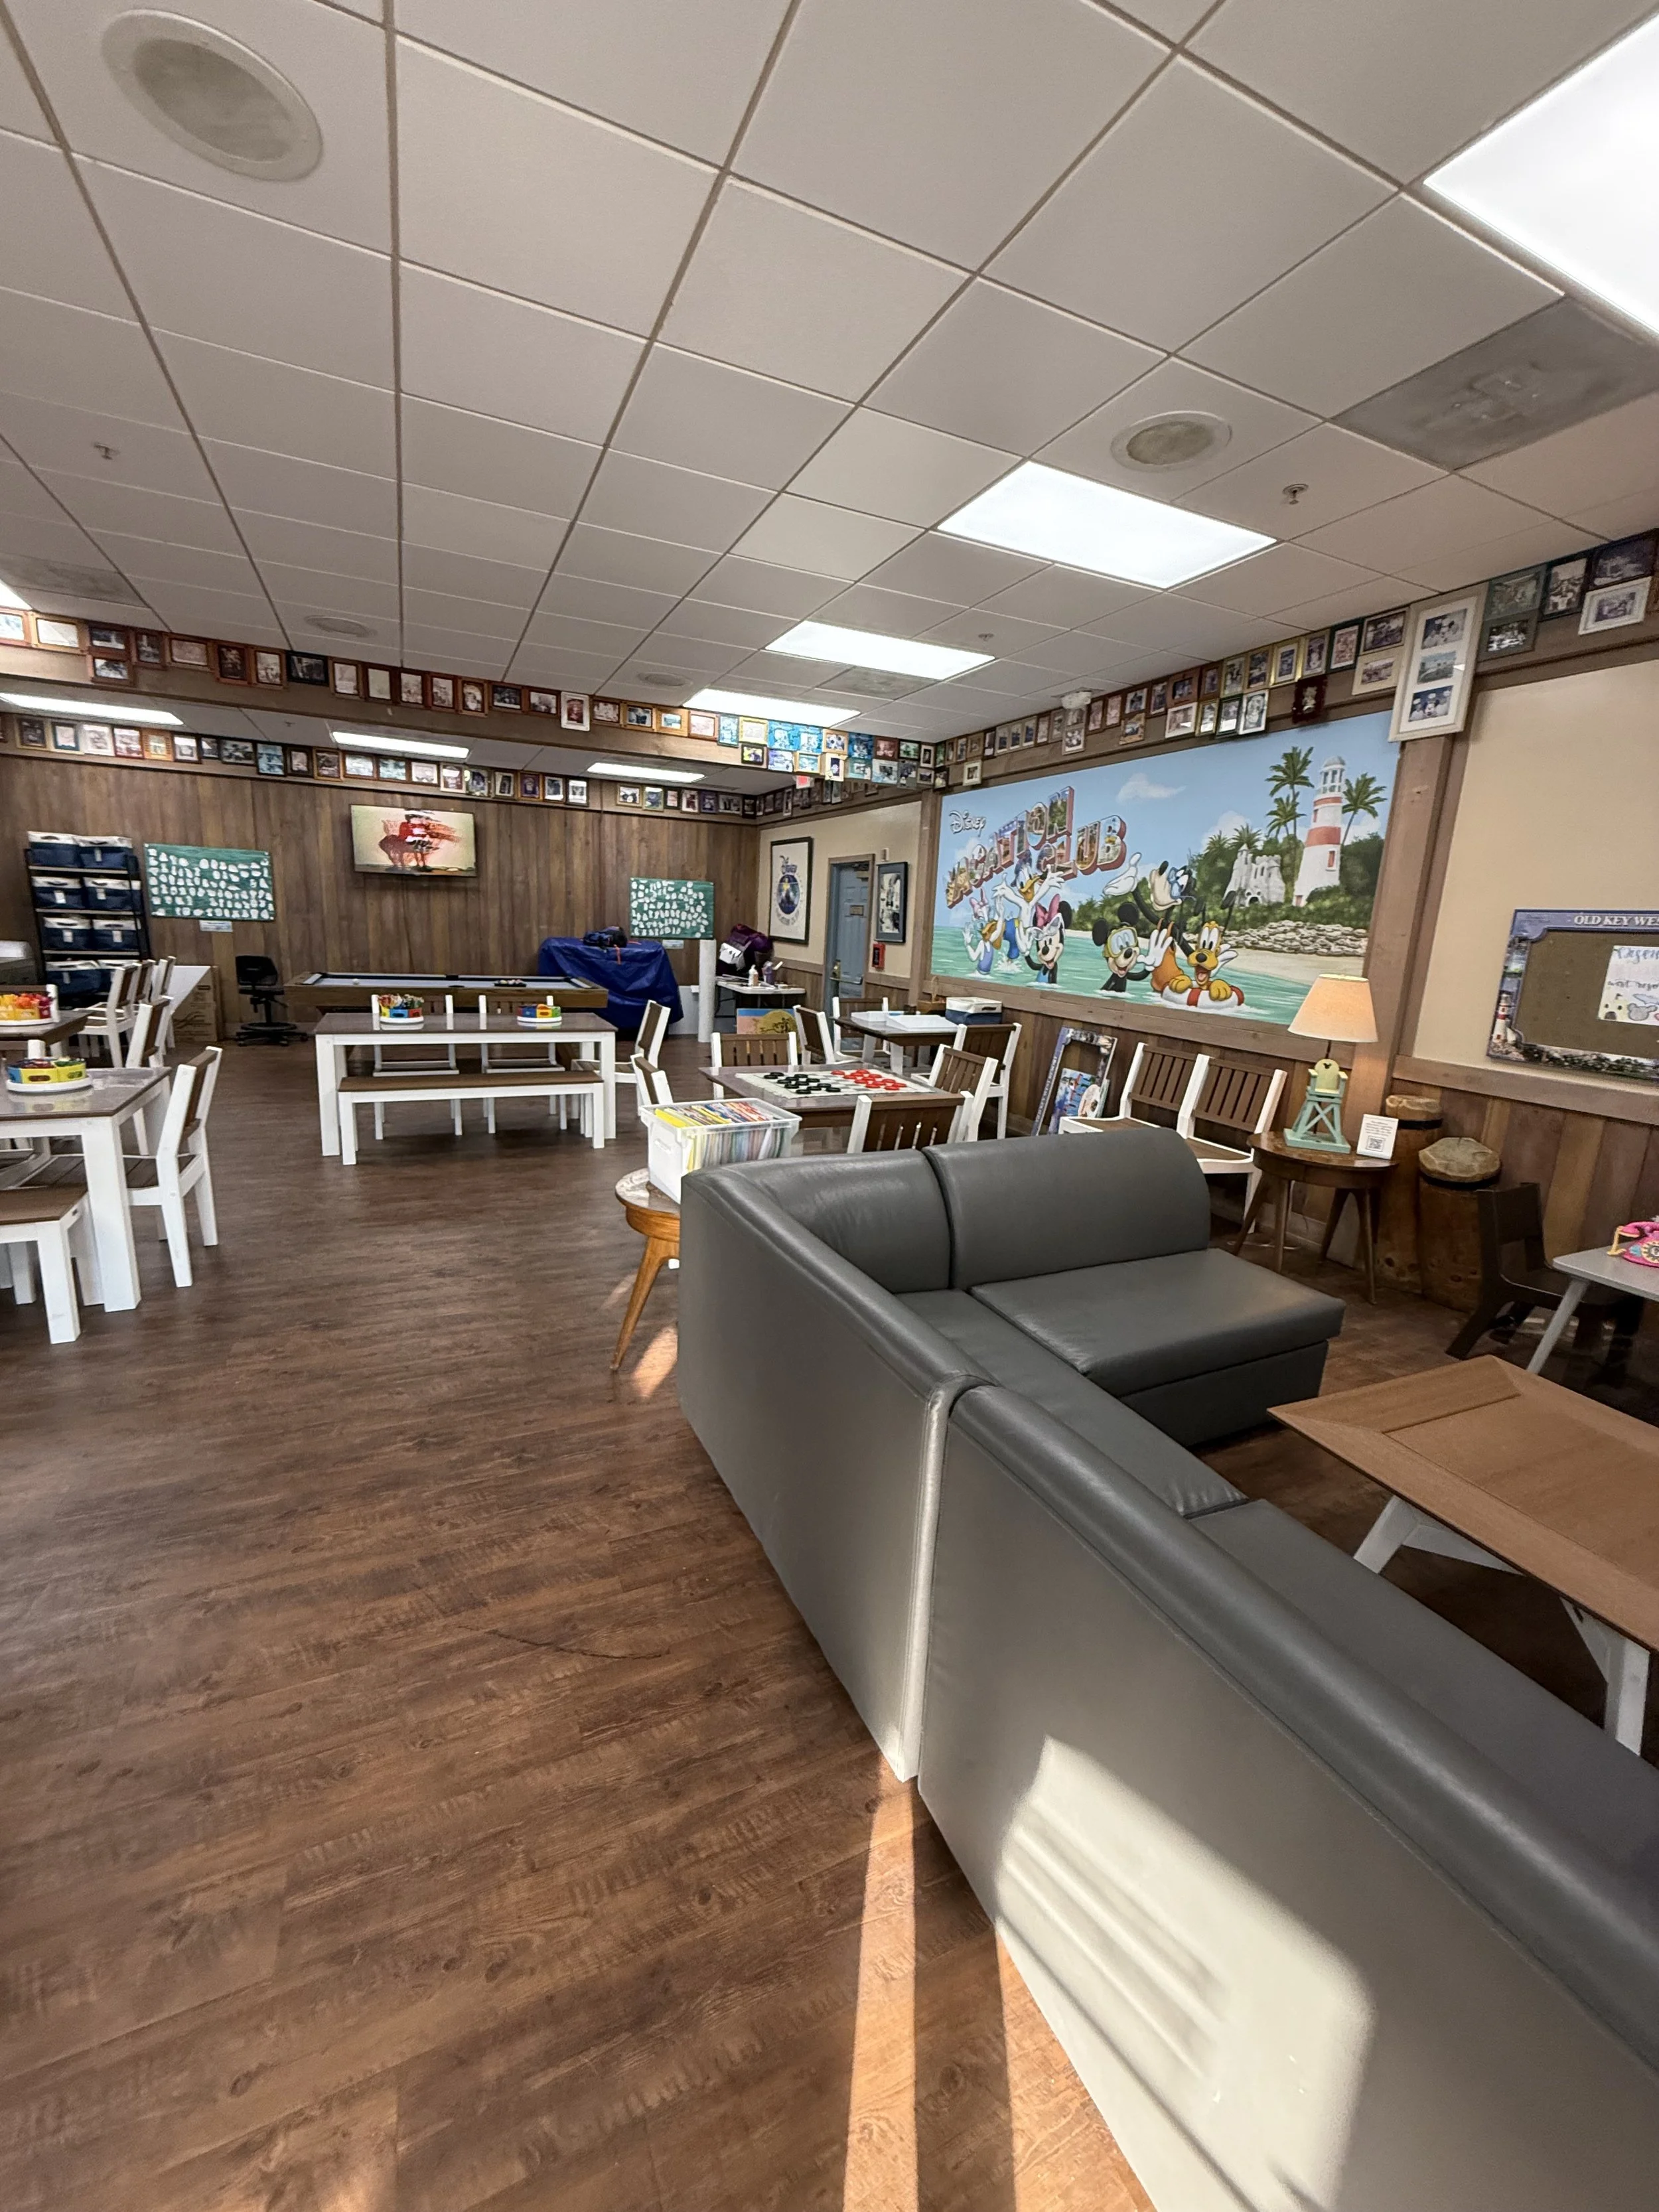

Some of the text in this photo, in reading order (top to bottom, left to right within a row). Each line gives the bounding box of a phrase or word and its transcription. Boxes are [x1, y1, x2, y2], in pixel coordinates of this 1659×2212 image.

[946, 786, 1074, 909] VACATION
[1036, 815, 1127, 887] CLUB
[1574, 915, 1602, 926] OLD
[1603, 915, 1631, 926] KEY
